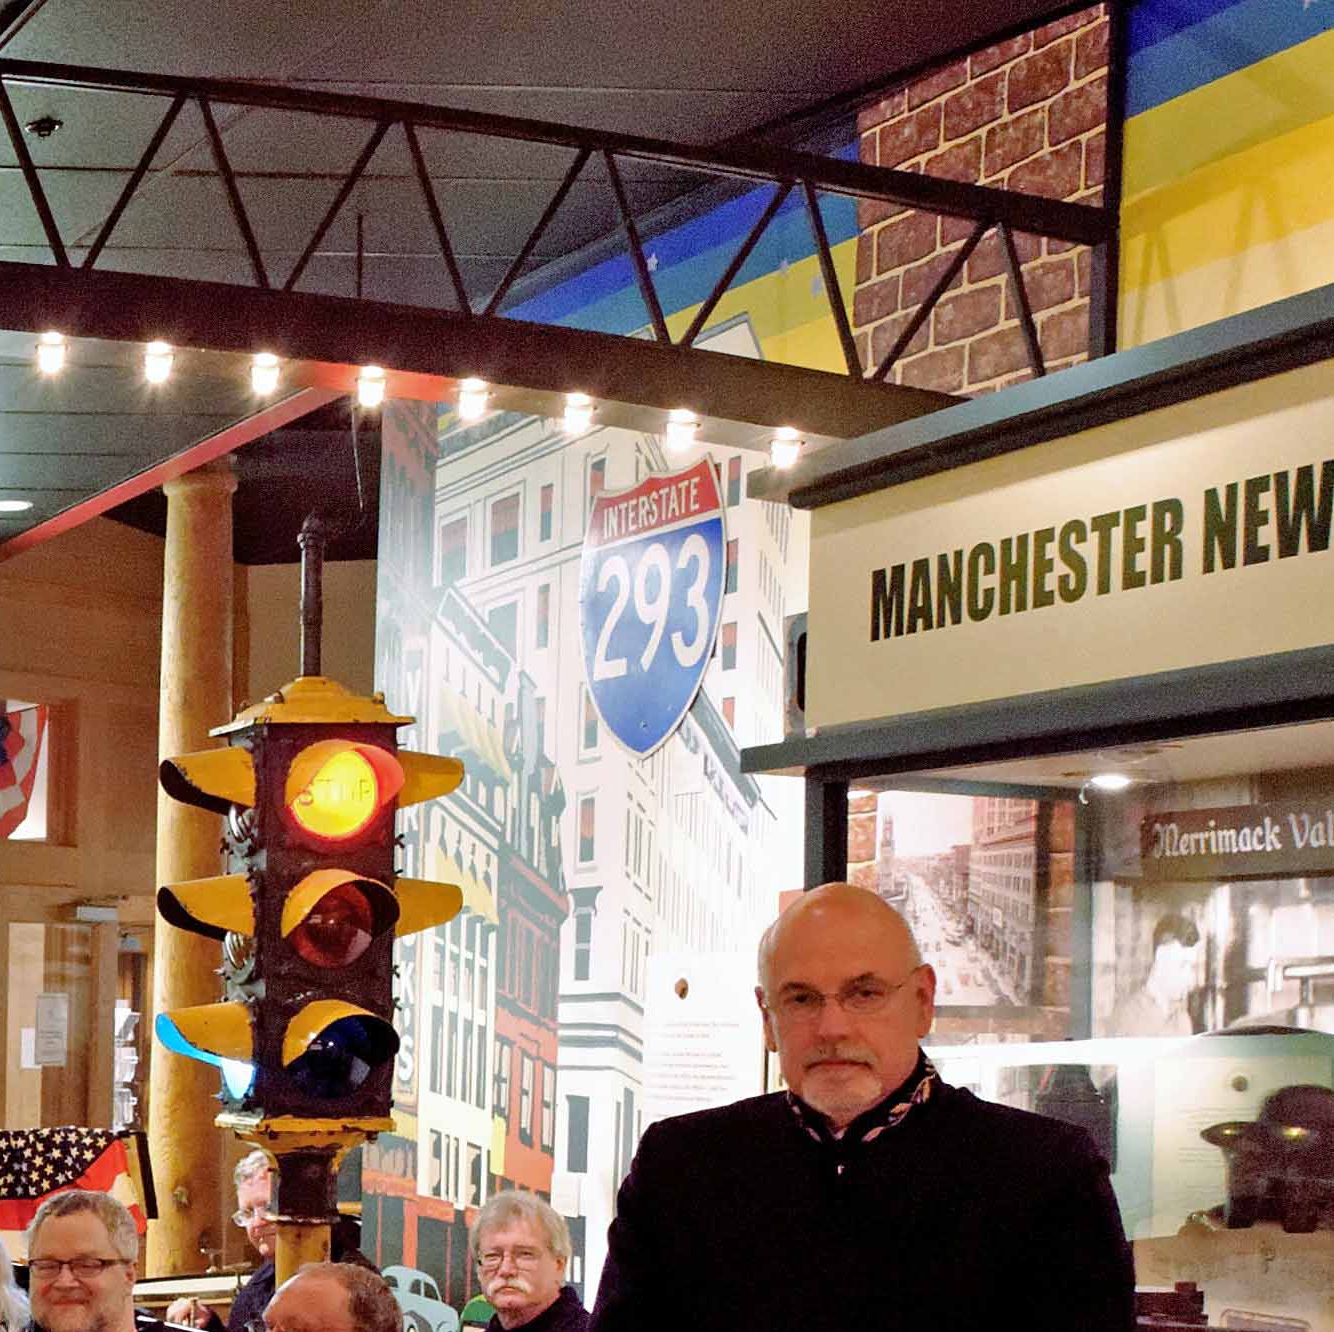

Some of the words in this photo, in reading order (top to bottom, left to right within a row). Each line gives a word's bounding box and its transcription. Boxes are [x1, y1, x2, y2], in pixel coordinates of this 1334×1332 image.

[602, 475, 701, 540] INTERSTATE
[870, 497, 1184, 643] MANCHESTER
[1202, 459, 1334, 575] NEW
[593, 533, 711, 682] 293
[1153, 815, 1283, 859] Merrimack
